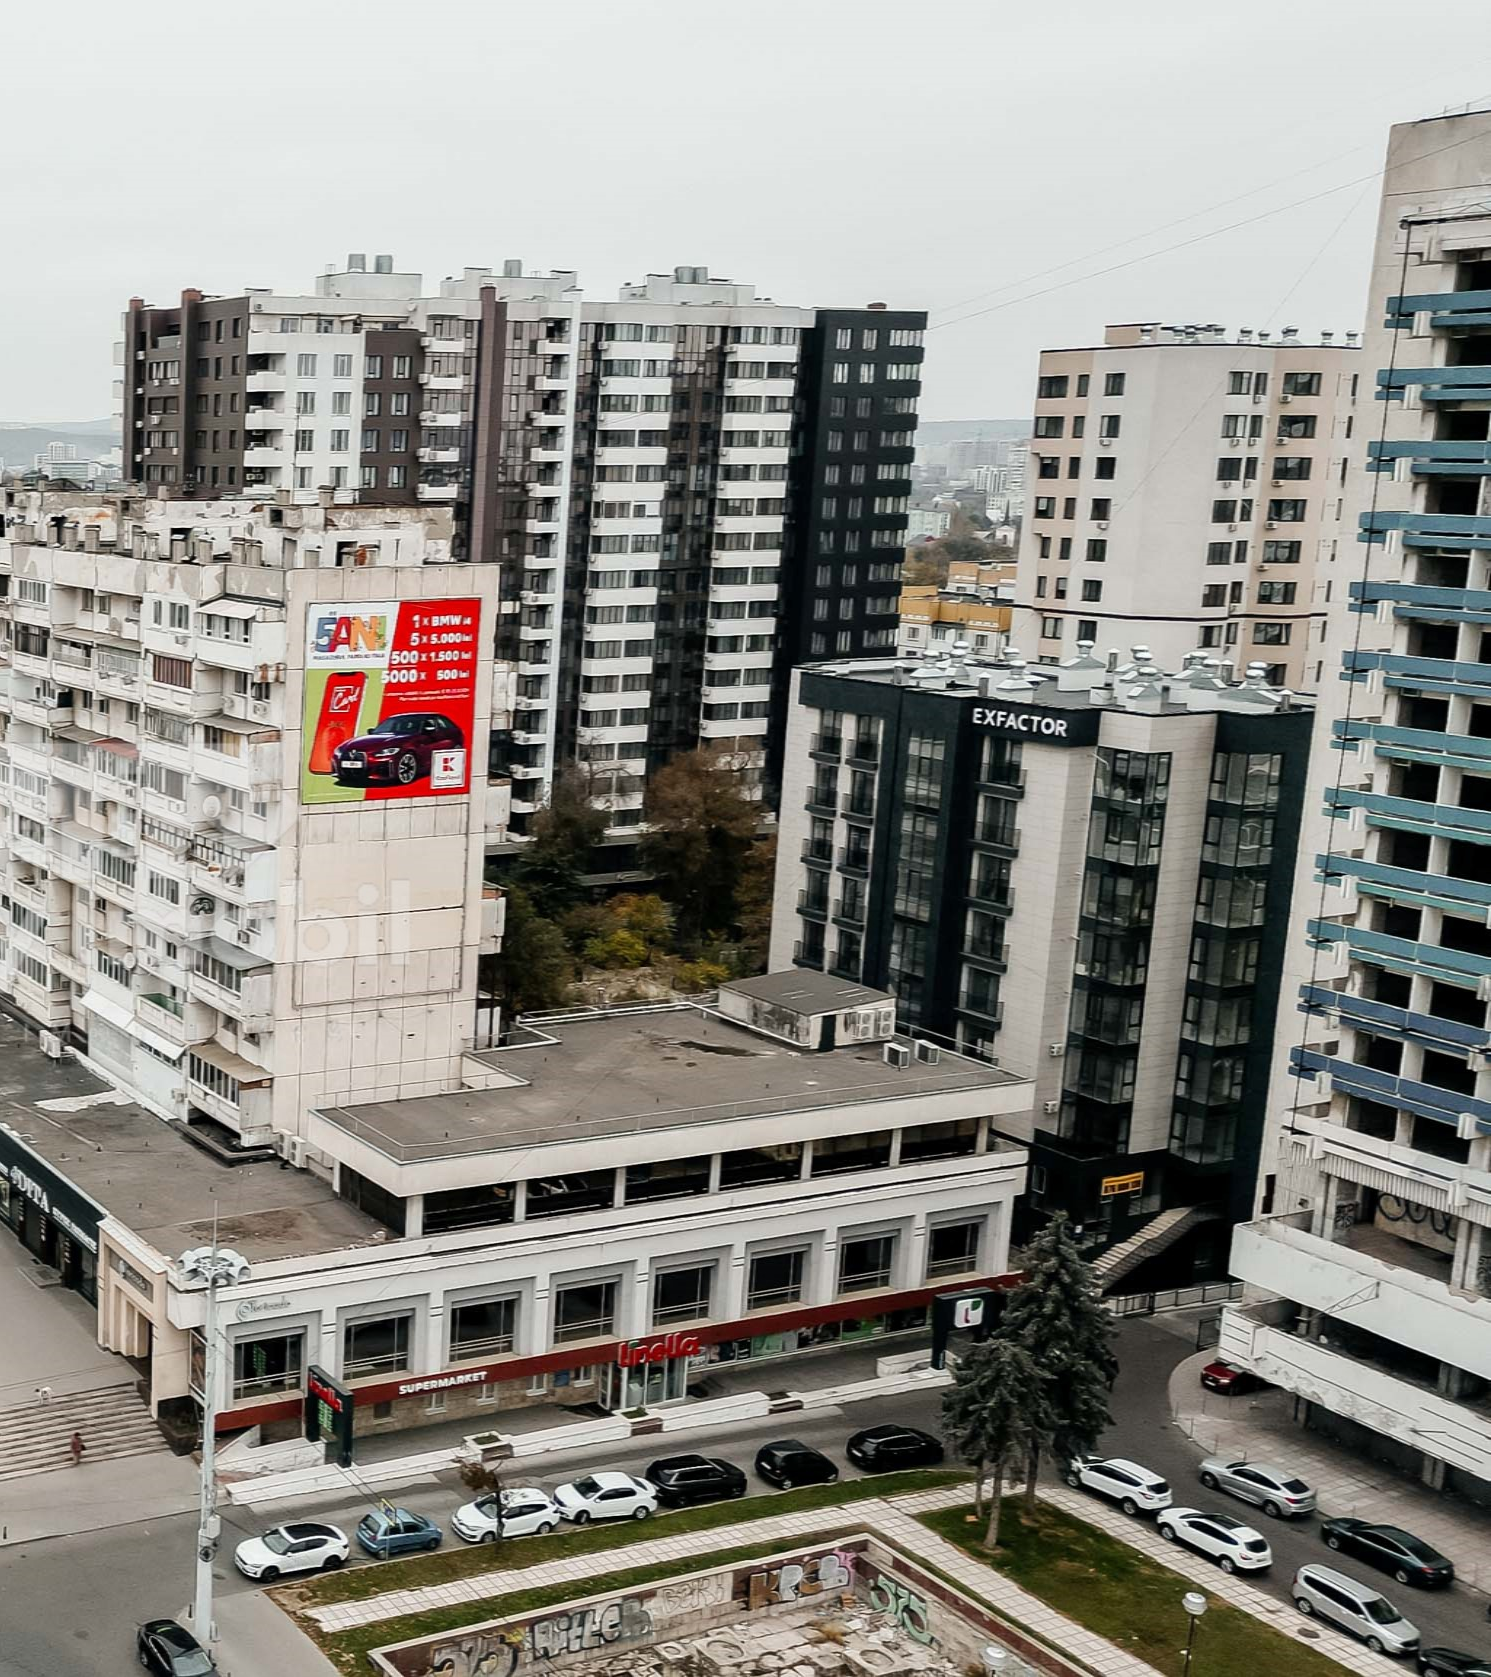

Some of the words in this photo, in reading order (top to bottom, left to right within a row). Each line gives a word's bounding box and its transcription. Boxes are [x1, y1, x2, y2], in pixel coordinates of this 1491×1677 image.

[413, 614, 421, 629] 1
[431, 615, 462, 627] BMW
[410, 632, 420, 647] 5
[430, 633, 462, 645] 5.000
[391, 650, 419, 665] 500
[430, 650, 460, 663] 1.500
[381, 669, 418, 684] 5000
[436, 669, 459, 681] 500
[971, 707, 1068, 738] EXFACTOR
[398, 1370, 488, 1395] SUPERMARKET
